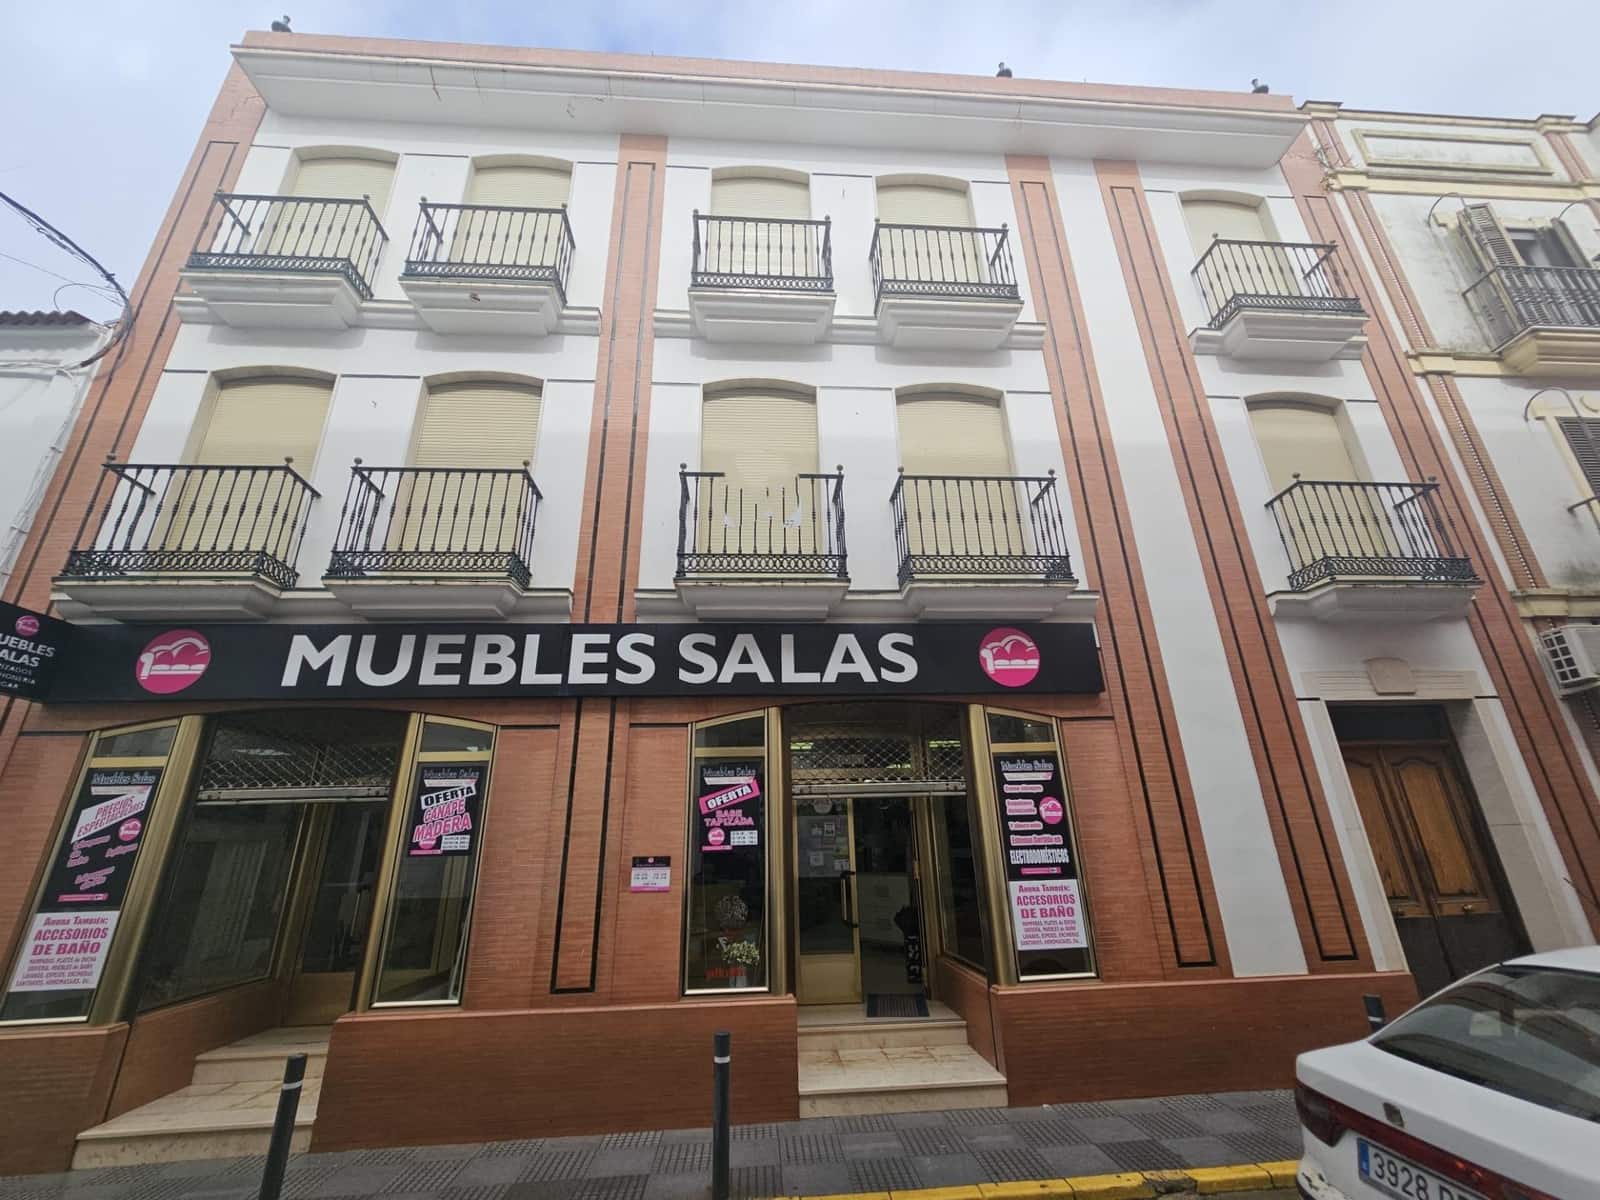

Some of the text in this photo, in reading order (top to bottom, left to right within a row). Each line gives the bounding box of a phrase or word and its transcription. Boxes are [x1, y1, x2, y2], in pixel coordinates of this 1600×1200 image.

[0, 633, 56, 657] UEBLES
[0, 649, 40, 667] ALAS
[281, 632, 918, 686] MUEBLES SALAS
[424, 786, 474, 806] OFERTA
[707, 785, 752, 809] OFERTA
[413, 812, 472, 843] MADERA
[704, 817, 755, 827] TAPIZADA
[1017, 894, 1076, 906] ACCESORIOS
[1020, 905, 1075, 919] DE BAÑO
[34, 927, 109, 941] ACCESORIOS
[32, 940, 101, 955] DE BAÑO
[1373, 1153, 1429, 1200] 3928
